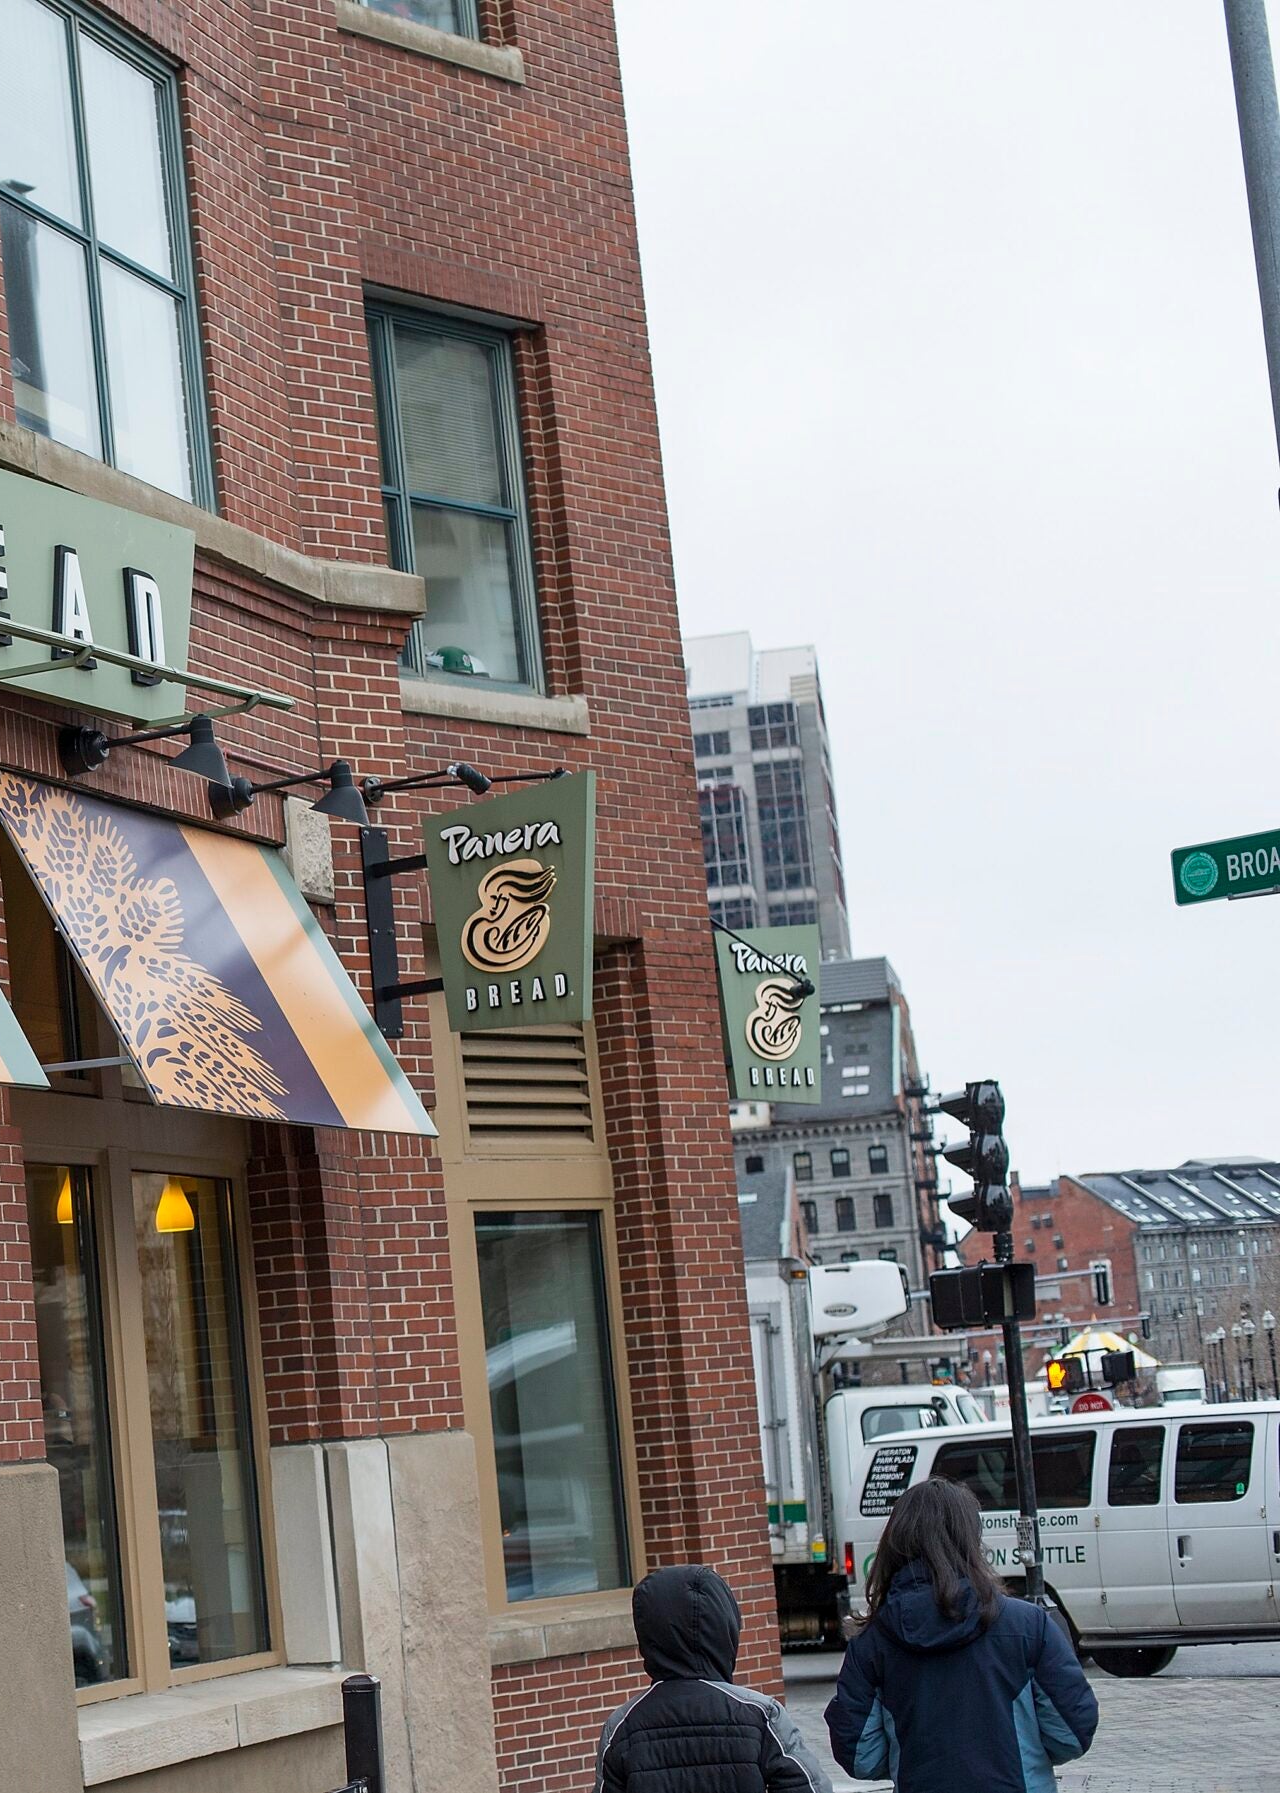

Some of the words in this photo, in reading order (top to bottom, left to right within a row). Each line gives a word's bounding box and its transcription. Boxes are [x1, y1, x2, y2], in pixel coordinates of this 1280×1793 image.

[439, 820, 562, 866] Panera
[729, 941, 808, 974] Panera
[749, 1066, 815, 1087] BREAD
[1090, 1401, 1104, 1409] NOT
[877, 1448, 912, 1456] SHERATON
[876, 1456, 893, 1464] PARK
[894, 1455, 915, 1463] PLAZA
[871, 1472, 905, 1480] FAIRMONT
[862, 1498, 887, 1506] WESTIN
[1011, 1546, 1086, 1566] STTLE
